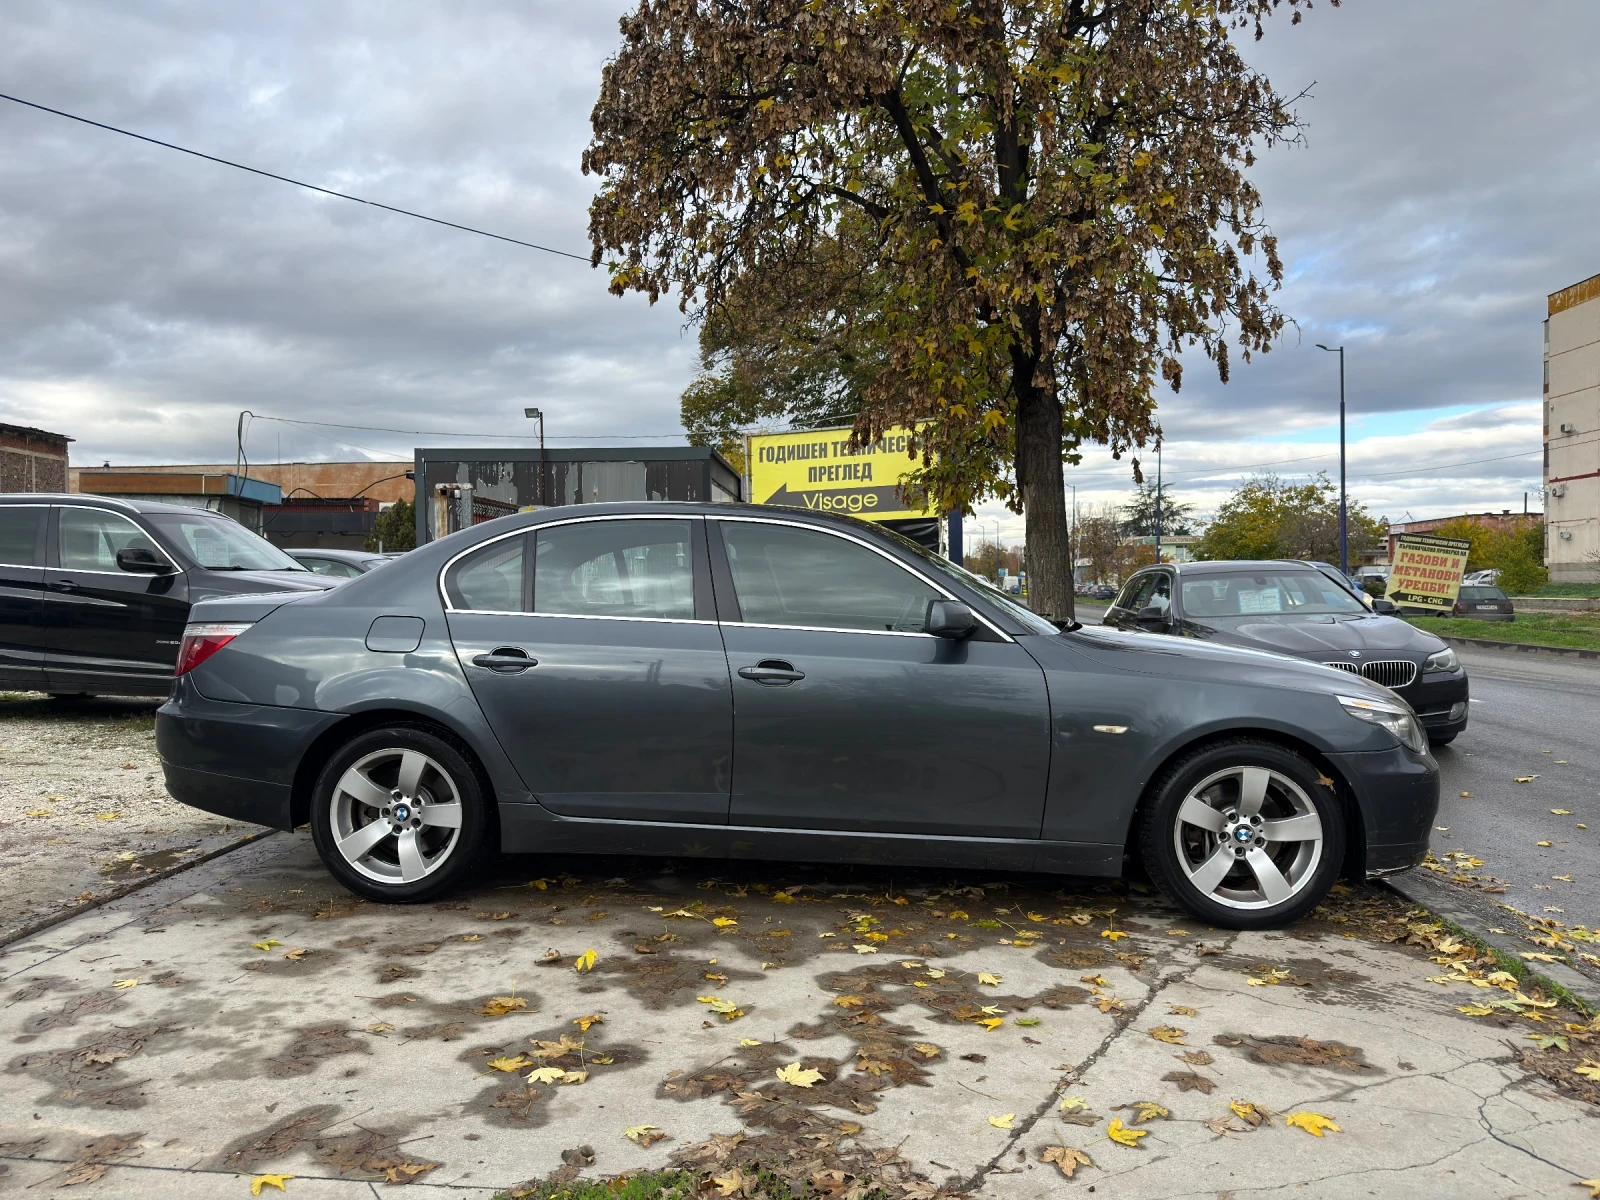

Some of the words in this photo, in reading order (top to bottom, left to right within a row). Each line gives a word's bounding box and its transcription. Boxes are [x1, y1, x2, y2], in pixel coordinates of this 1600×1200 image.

[759, 442, 828, 464] ГОДИШЕН
[808, 462, 873, 483] ПРЕГЛЕД
[802, 493, 878, 512] Visage
[1400, 553, 1448, 566] ГАЗОВИ
[1451, 558, 1460, 568] И
[1393, 564, 1461, 582] МЕТАНОВИ
[1397, 578, 1451, 594] УРЕДБИ!
[1427, 597, 1443, 605] CNG
